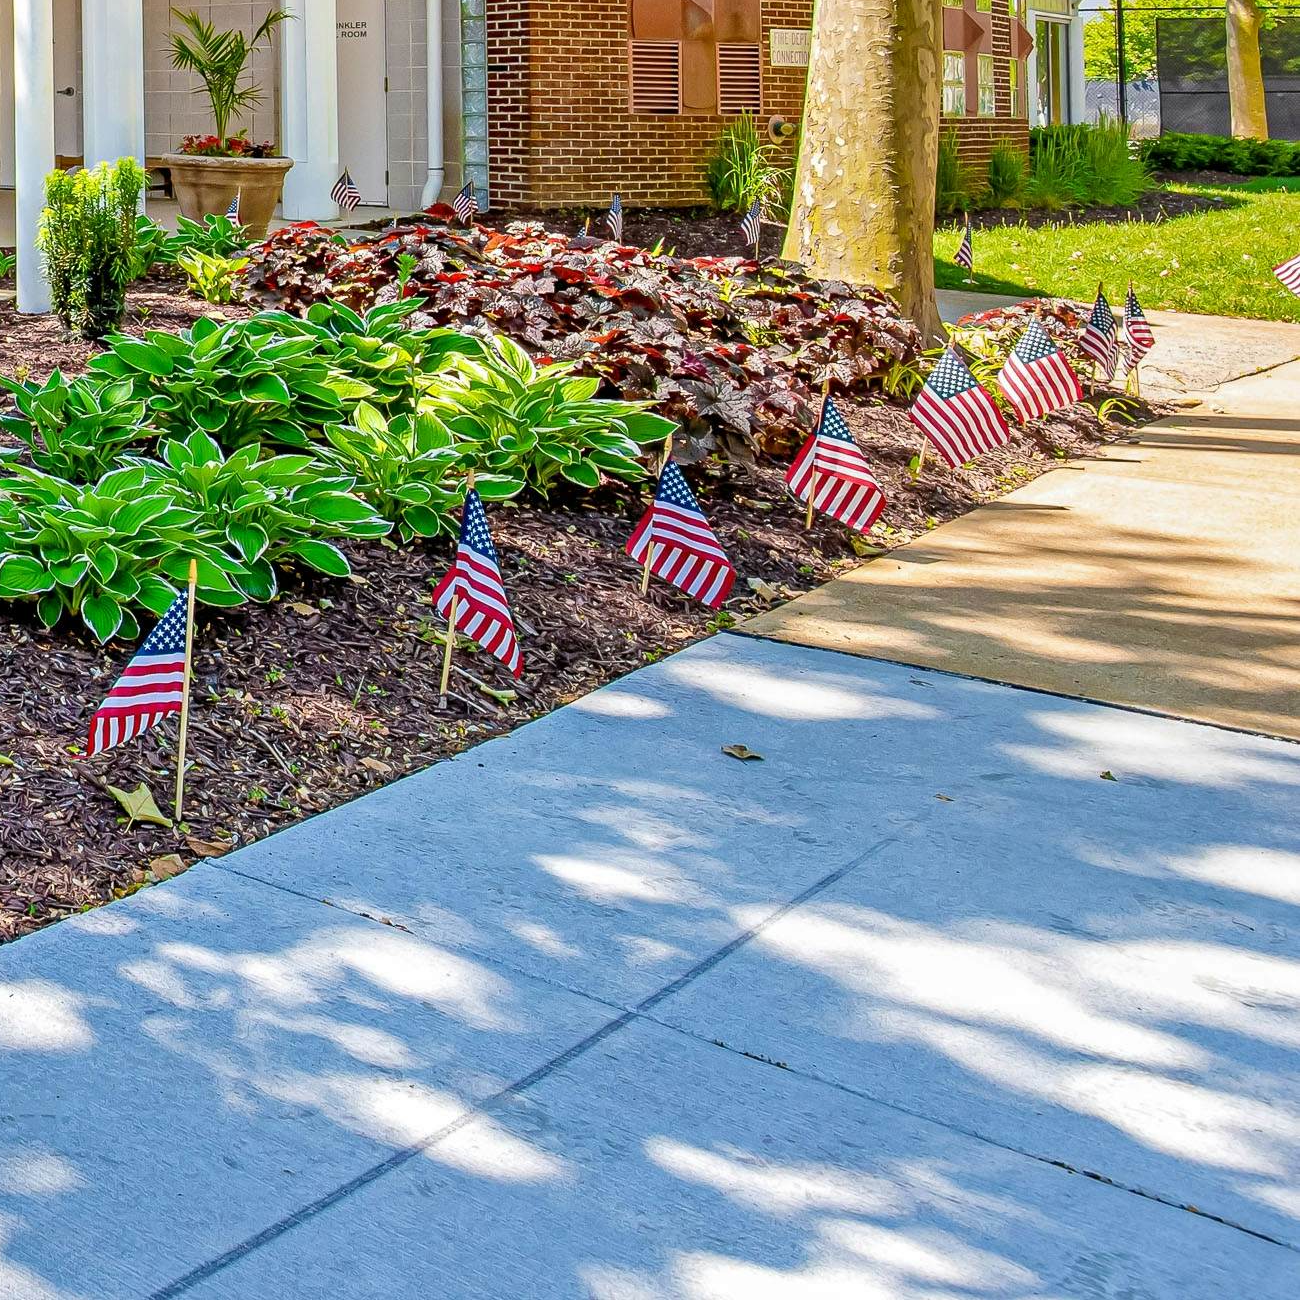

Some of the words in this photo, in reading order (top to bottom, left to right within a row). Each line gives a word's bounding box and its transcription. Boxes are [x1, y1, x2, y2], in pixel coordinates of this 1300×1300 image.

[336, 21, 367, 29] INKLER
[774, 32, 788, 44] FIRE
[773, 50, 809, 64] CONNECTIO
